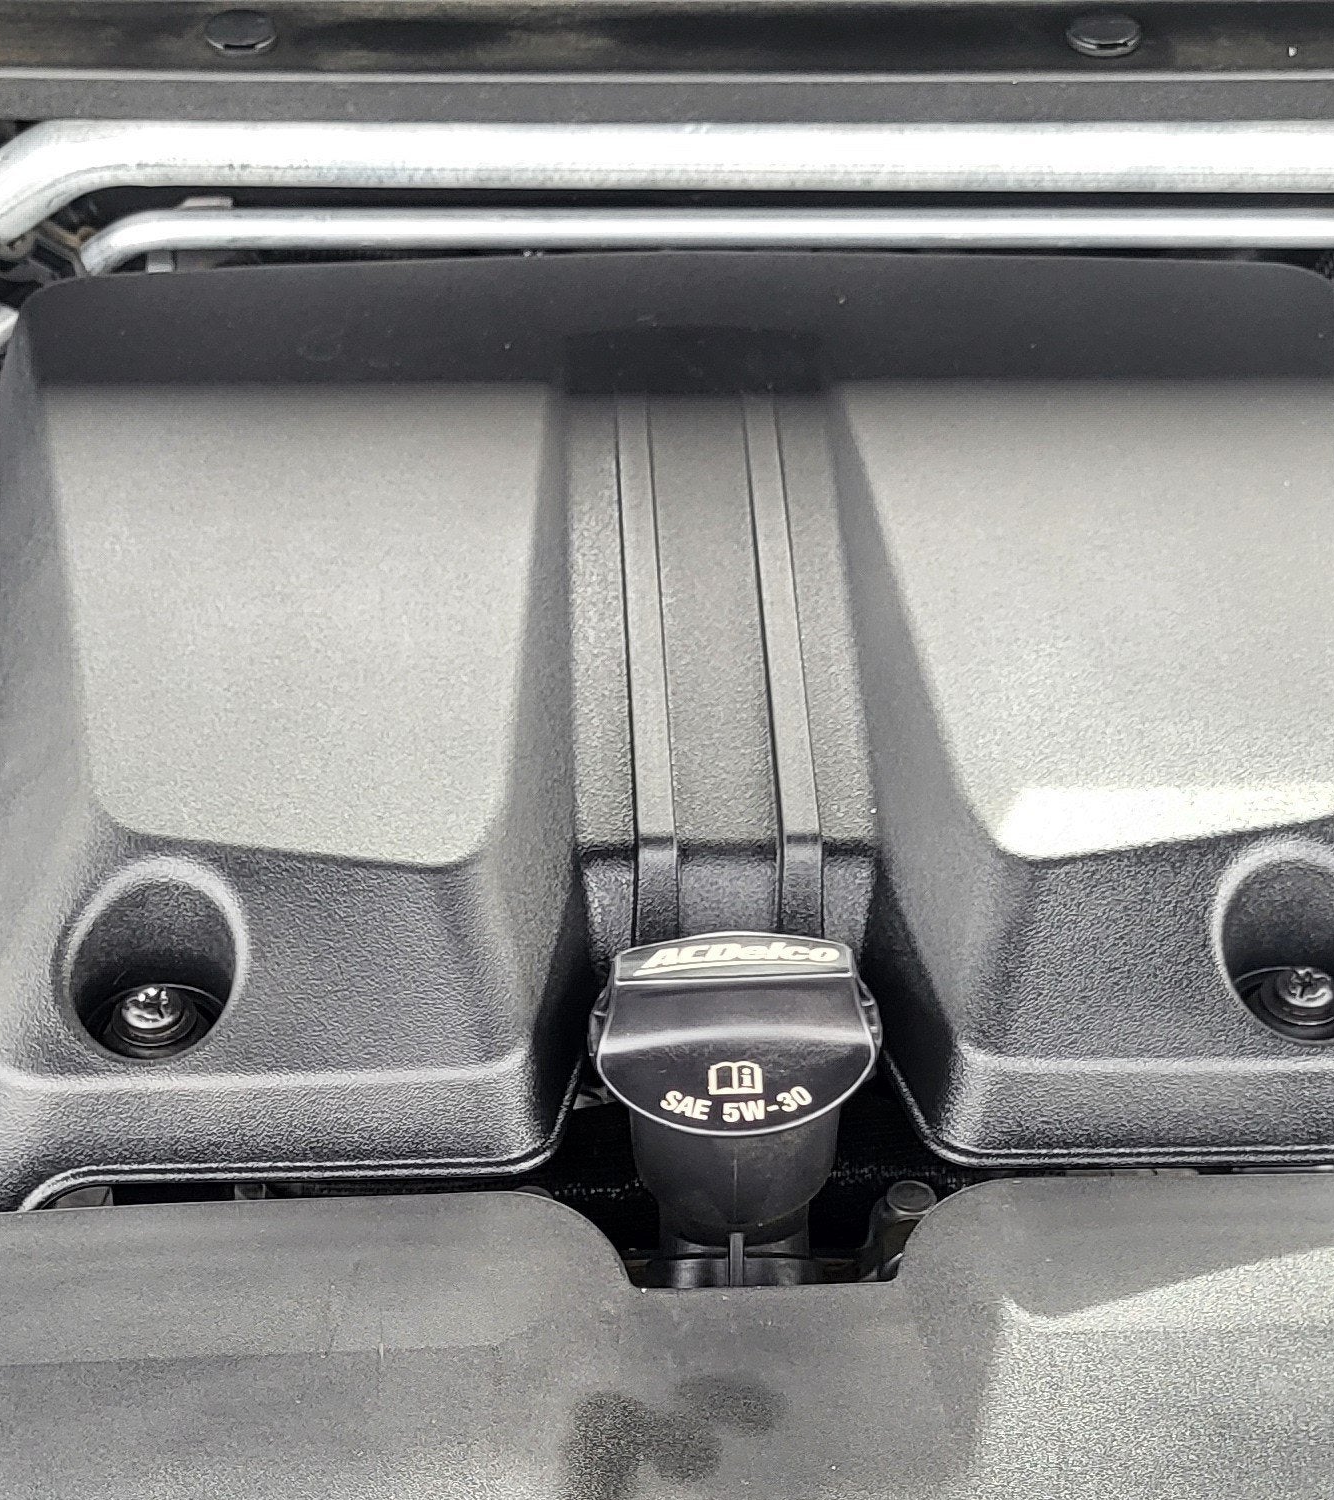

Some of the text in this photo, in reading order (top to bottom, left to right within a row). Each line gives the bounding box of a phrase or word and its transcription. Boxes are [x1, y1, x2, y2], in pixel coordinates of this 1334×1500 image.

[640, 942, 841, 969] ACDelco
[660, 1086, 813, 1123] SAE 5W-30
